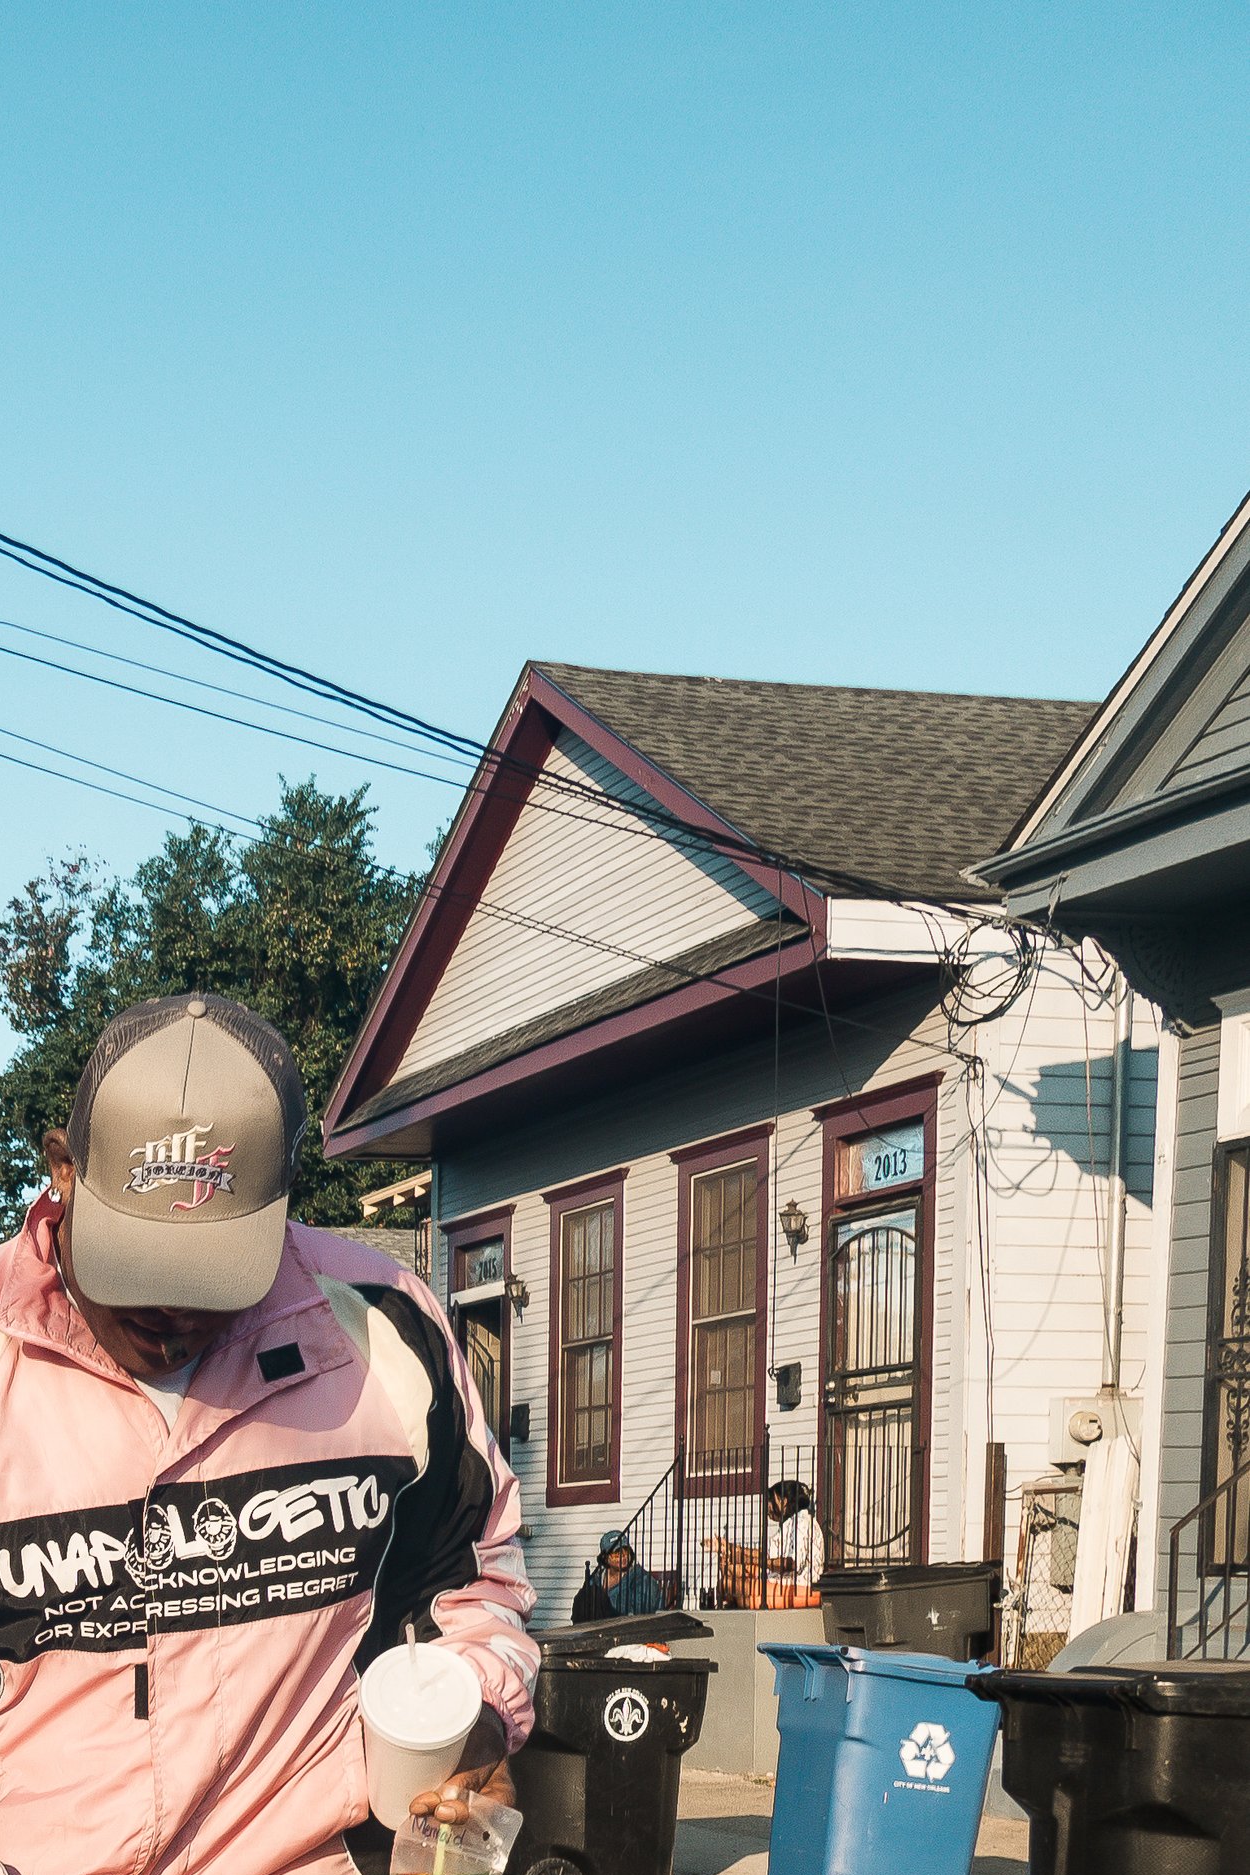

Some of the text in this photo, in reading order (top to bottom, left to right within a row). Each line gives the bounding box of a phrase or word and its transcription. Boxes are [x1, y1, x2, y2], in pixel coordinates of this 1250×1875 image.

[874, 1149, 908, 1182] 2013
[34, 1623, 73, 1645] OR
[266, 1571, 359, 1603] REGRET
[44, 1595, 104, 1621] NOT
